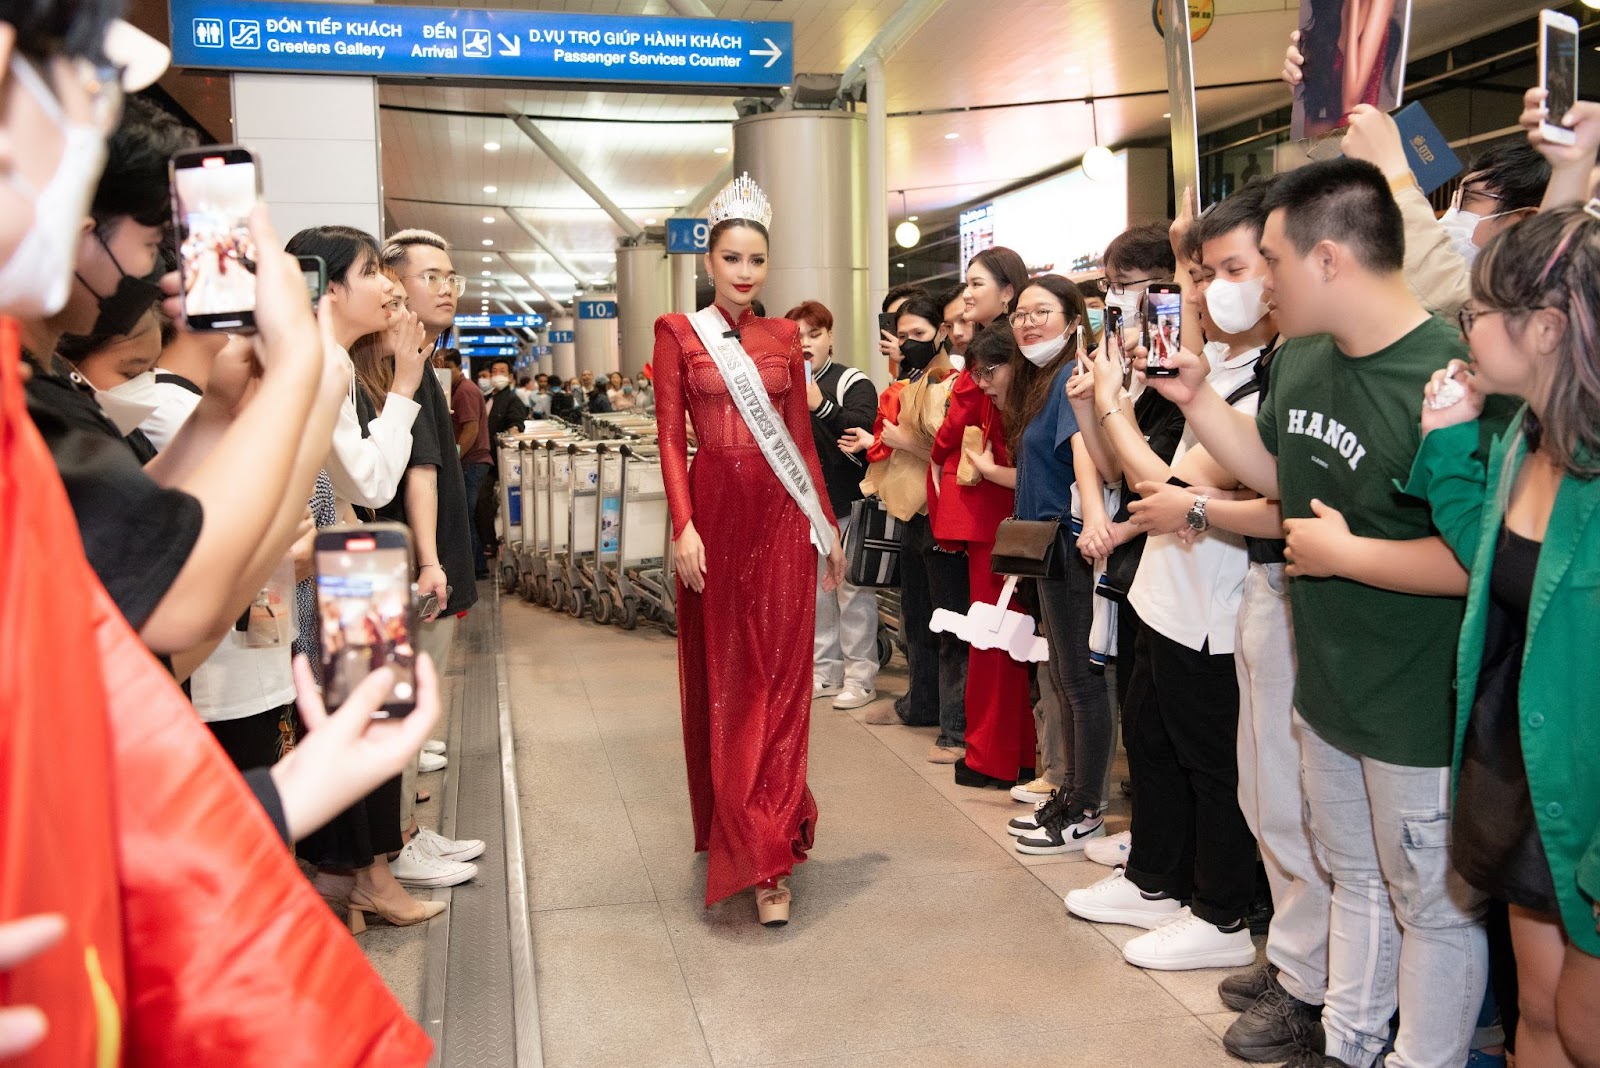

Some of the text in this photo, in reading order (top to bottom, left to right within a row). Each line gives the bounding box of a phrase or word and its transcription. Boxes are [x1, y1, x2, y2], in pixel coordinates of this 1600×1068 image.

[266, 17, 402, 37] ĐÓN TIẾP KHÁCH
[423, 21, 457, 39] ĐẾN
[267, 39, 385, 59] Greeters Gallery
[529, 29, 742, 49] D.VỤ TRỢ GIÚP HÀNH KHÁCH
[411, 44, 458, 58] Arrival
[554, 49, 742, 67] Passenger Services Counter
[693, 223, 710, 248] 9
[587, 303, 607, 317] 10
[555, 332, 568, 342] 11
[733, 372, 778, 440] UNIVERSE
[772, 438, 810, 497] VIETNAM
[1287, 409, 1366, 471] HANOI
